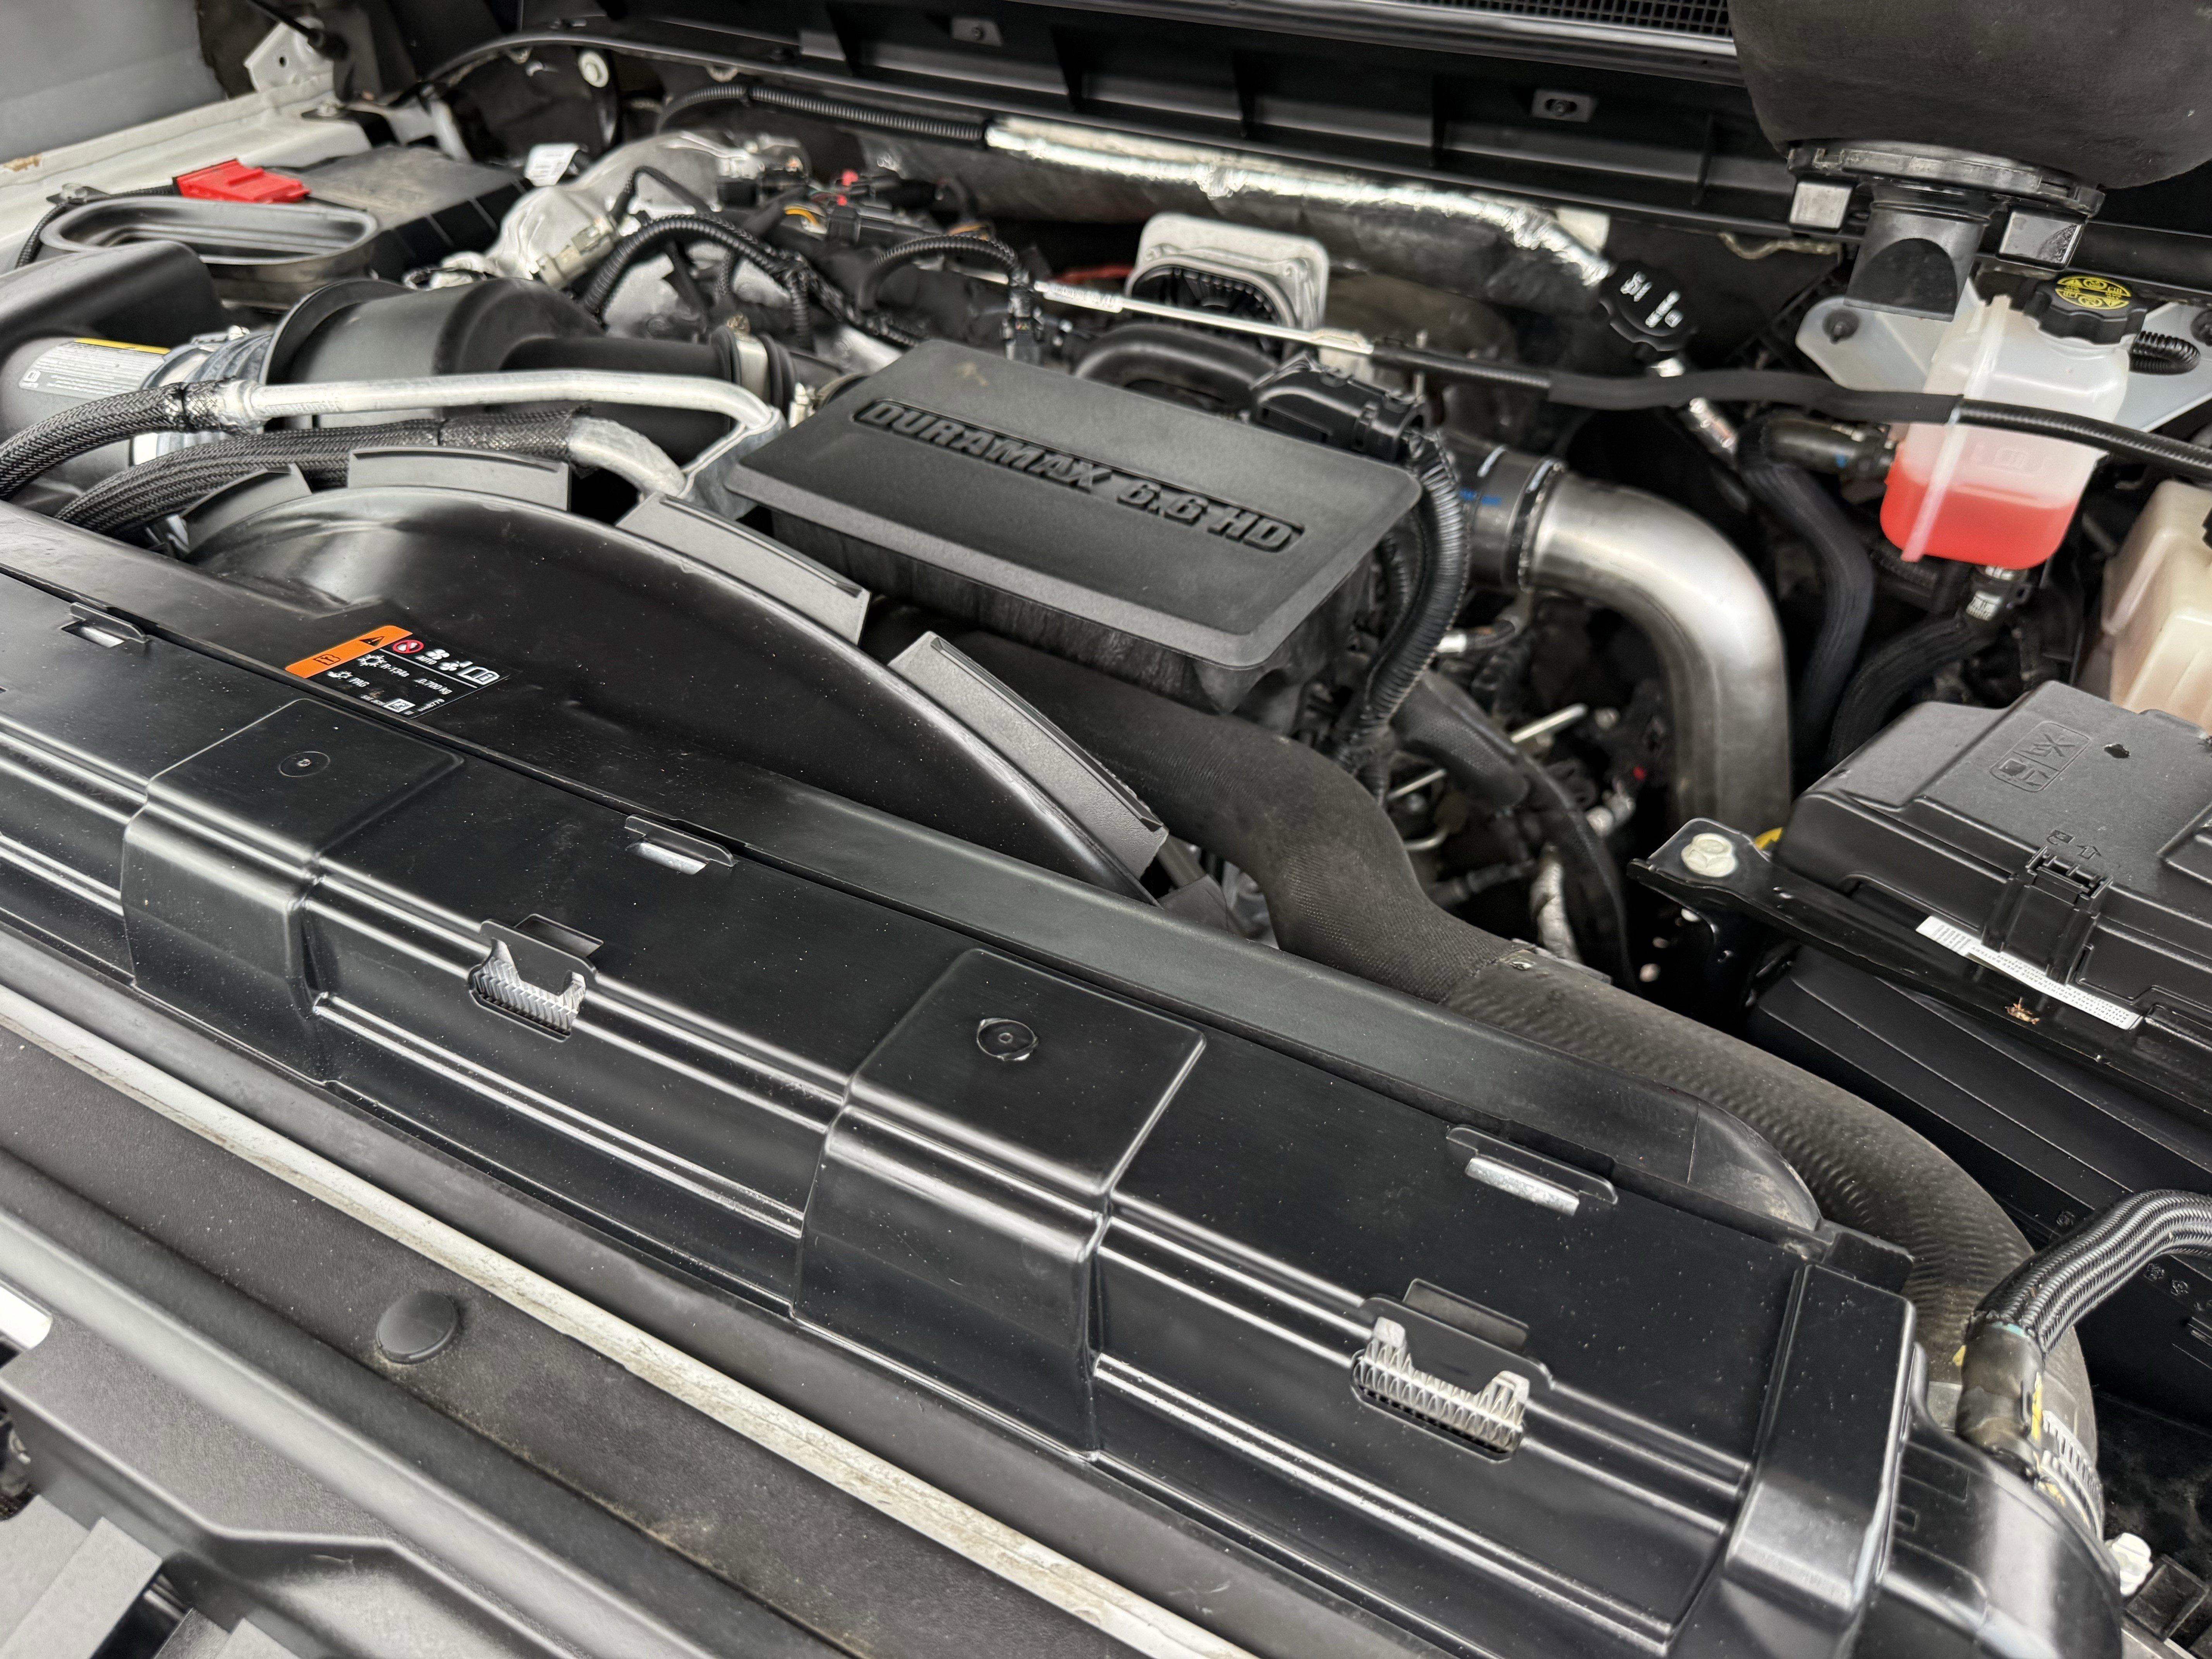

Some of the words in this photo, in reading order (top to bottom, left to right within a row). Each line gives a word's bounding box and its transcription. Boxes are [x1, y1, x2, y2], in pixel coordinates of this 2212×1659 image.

[860, 403, 1112, 494] DURAMAX
[1117, 479, 1209, 527] 6.6
[1207, 506, 1293, 553] HD
[414, 654, 437, 665] AUTO
[380, 663, 410, 677] R-134a
[349, 677, 370, 687] PAG
[1972, 946, 2001, 963] BATTERY
